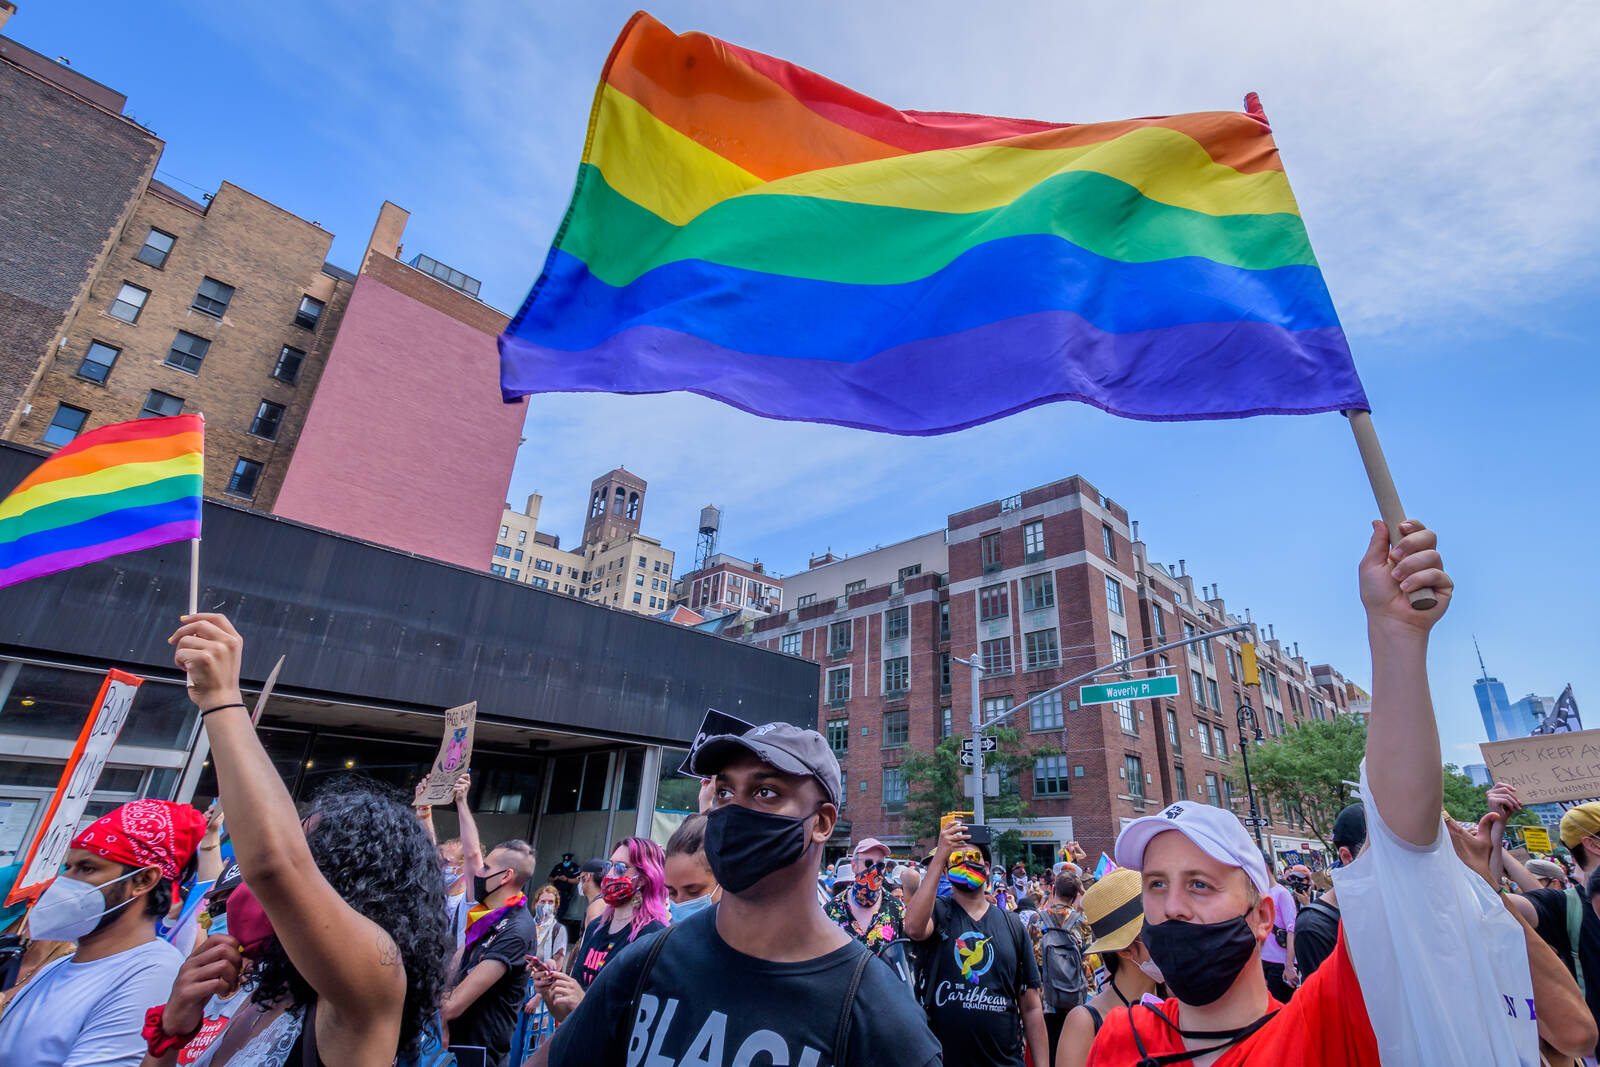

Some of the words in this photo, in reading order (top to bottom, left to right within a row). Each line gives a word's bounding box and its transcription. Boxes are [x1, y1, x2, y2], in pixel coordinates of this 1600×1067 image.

[1106, 685, 1138, 697] Waverly
[1141, 683, 1150, 694] Pl
[1536, 745, 1576, 760] KEEP
[935, 980, 1008, 1006] Caribbean
[963, 1001, 988, 1011] EQUALITY
